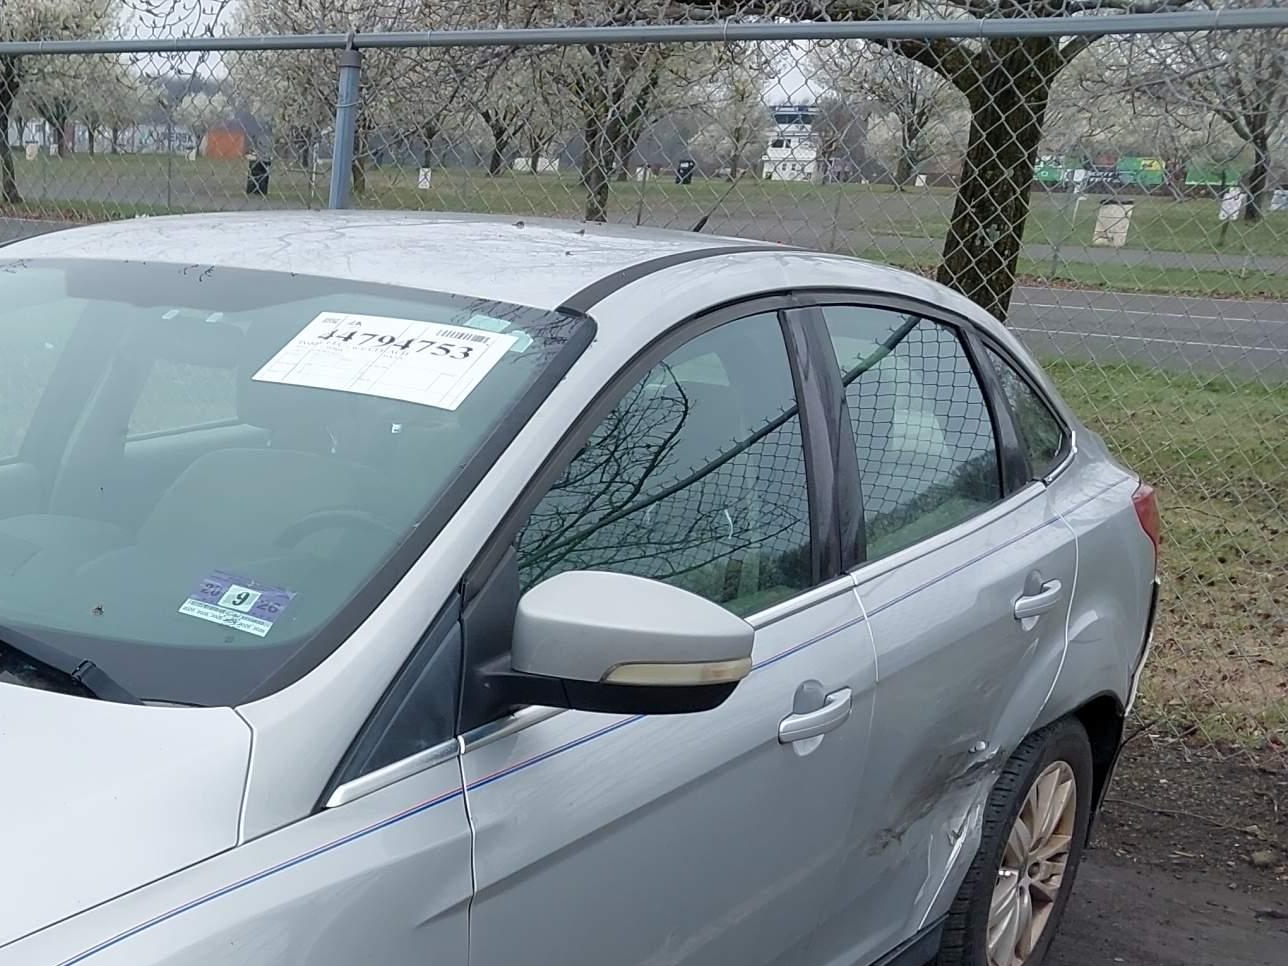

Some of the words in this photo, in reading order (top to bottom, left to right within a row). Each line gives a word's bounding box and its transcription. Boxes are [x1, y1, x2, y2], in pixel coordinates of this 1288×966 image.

[318, 329, 474, 360] 44794753
[232, 591, 250, 606] 9
[257, 600, 281, 613] 26
